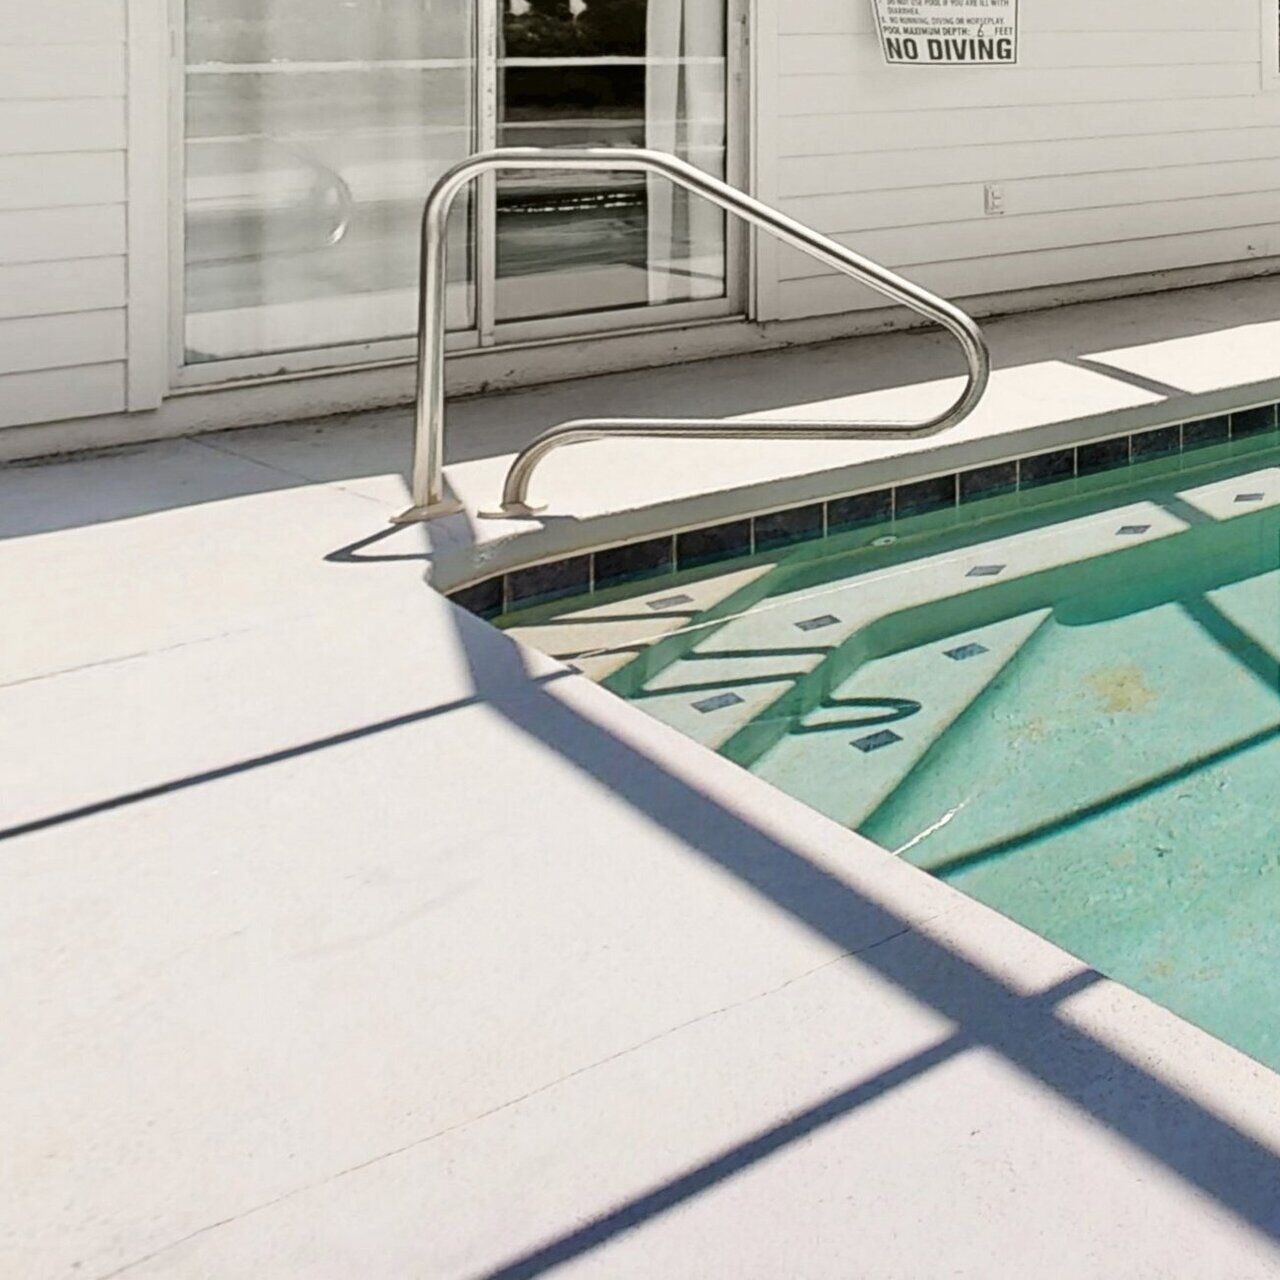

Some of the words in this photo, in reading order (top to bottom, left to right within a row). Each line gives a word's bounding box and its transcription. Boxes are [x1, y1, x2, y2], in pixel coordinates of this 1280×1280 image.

[882, 25, 902, 36] POOL
[902, 26, 941, 36] MAXIMUM
[976, 23, 984, 38] 6
[994, 26, 1013, 37] FEET
[886, 37, 919, 60] NO
[926, 38, 1012, 61] DIVING
